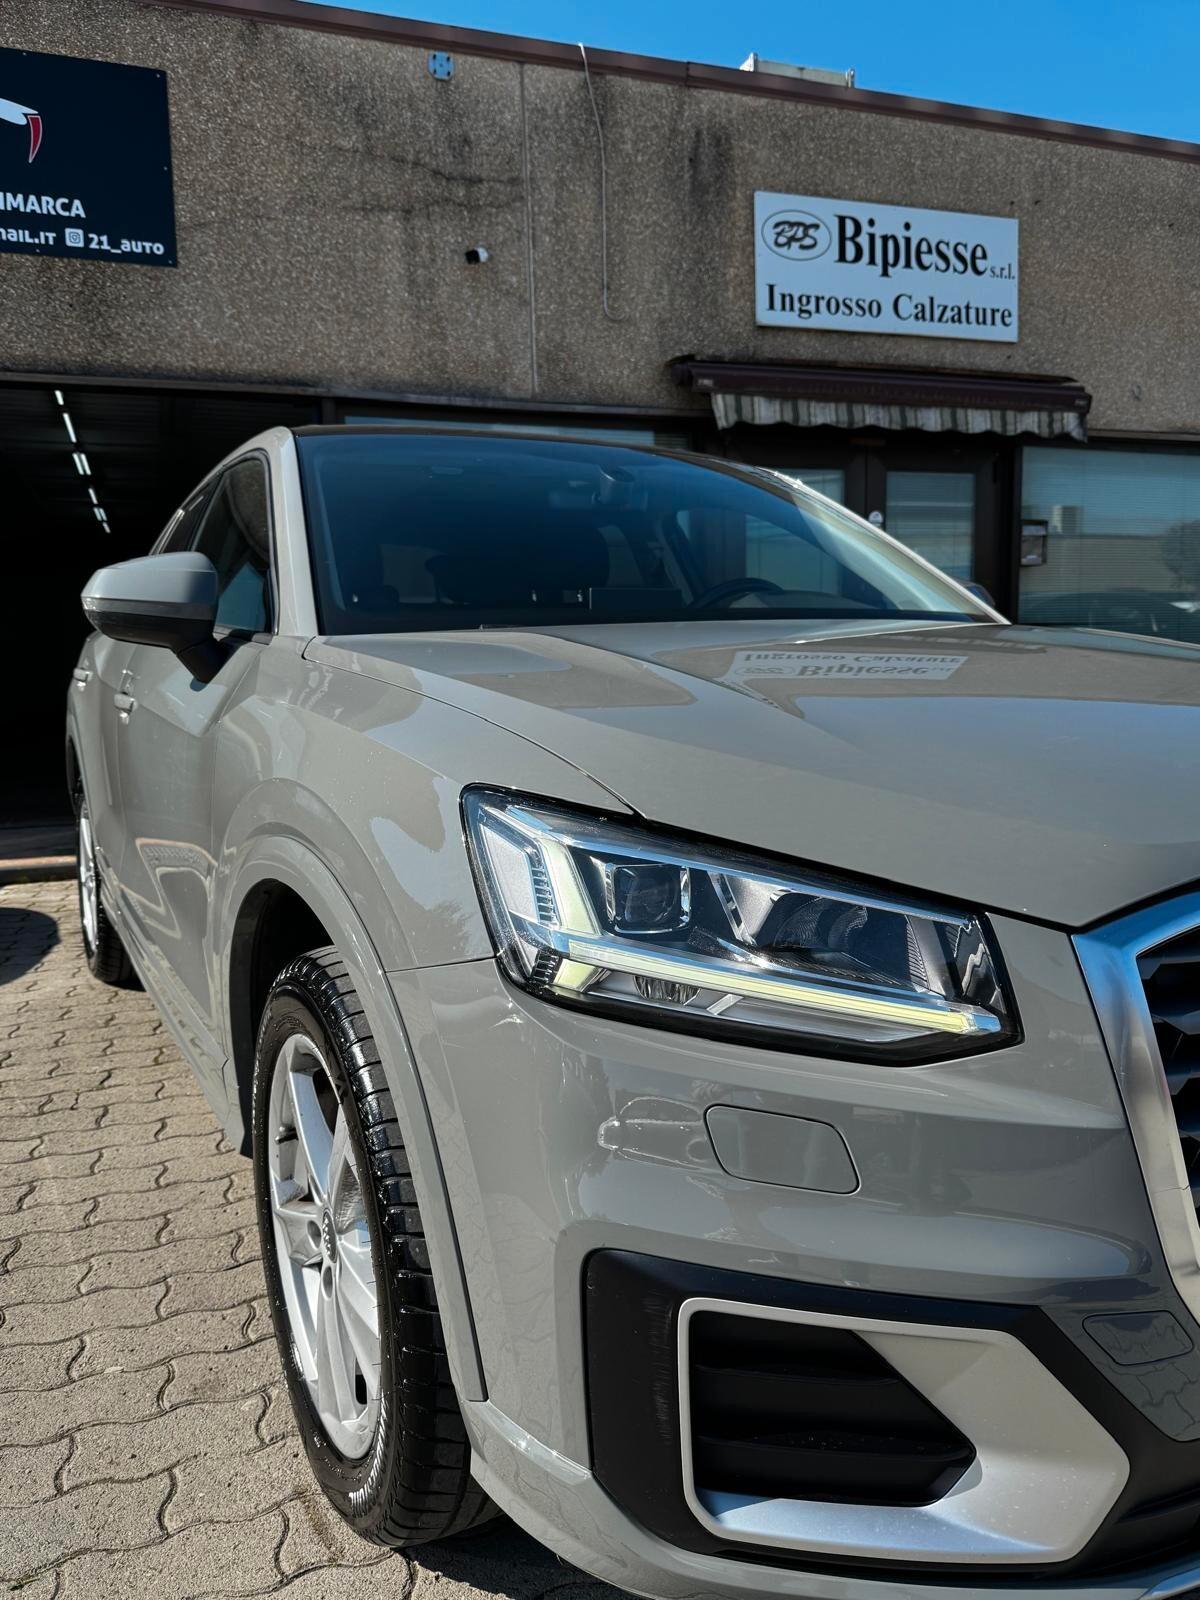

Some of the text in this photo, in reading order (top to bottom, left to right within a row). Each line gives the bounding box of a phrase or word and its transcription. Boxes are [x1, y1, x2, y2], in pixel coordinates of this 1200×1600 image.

[833, 213, 1016, 280] Bipiesse s.r.l.
[766, 283, 1012, 328] Ingrosso Calzature
